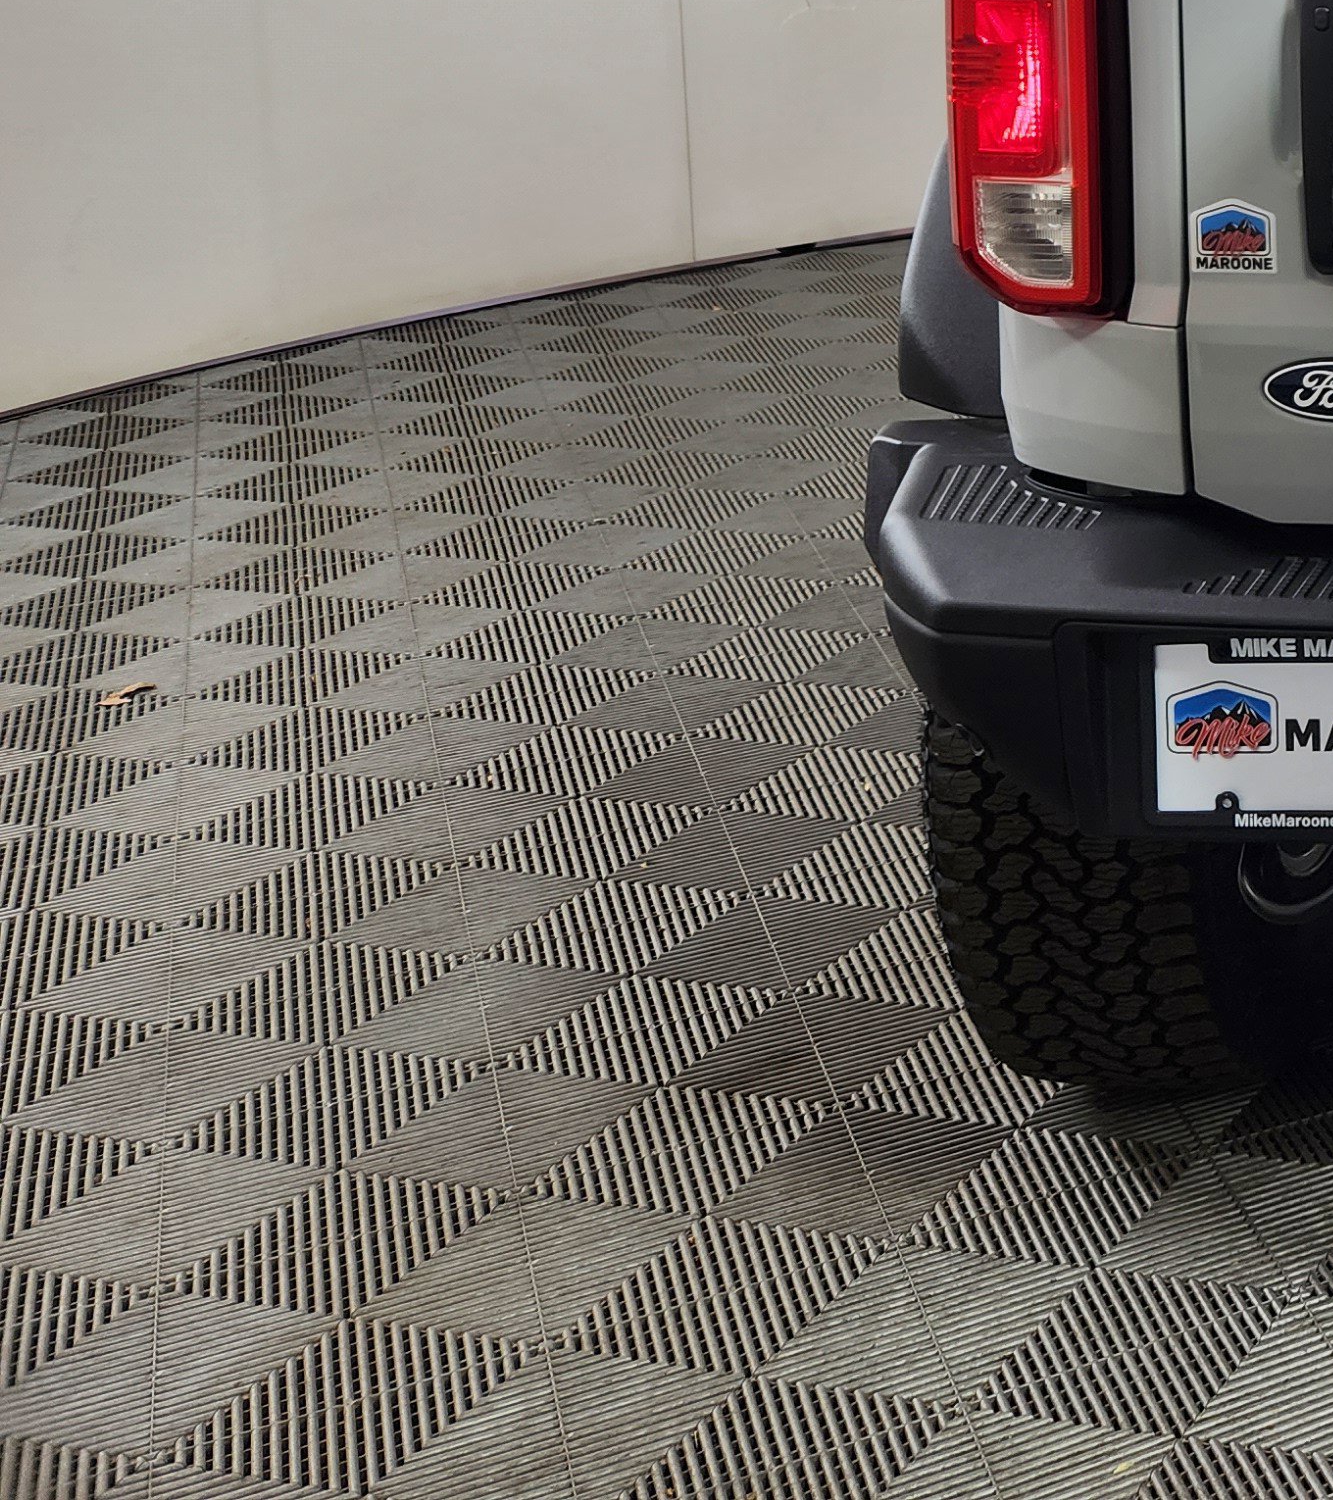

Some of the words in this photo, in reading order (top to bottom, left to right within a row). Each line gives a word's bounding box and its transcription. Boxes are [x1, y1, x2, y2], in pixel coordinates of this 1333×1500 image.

[1196, 257, 1273, 270] MAROONE
[1230, 637, 1298, 658] MIKE
[1175, 713, 1272, 761] Mike
